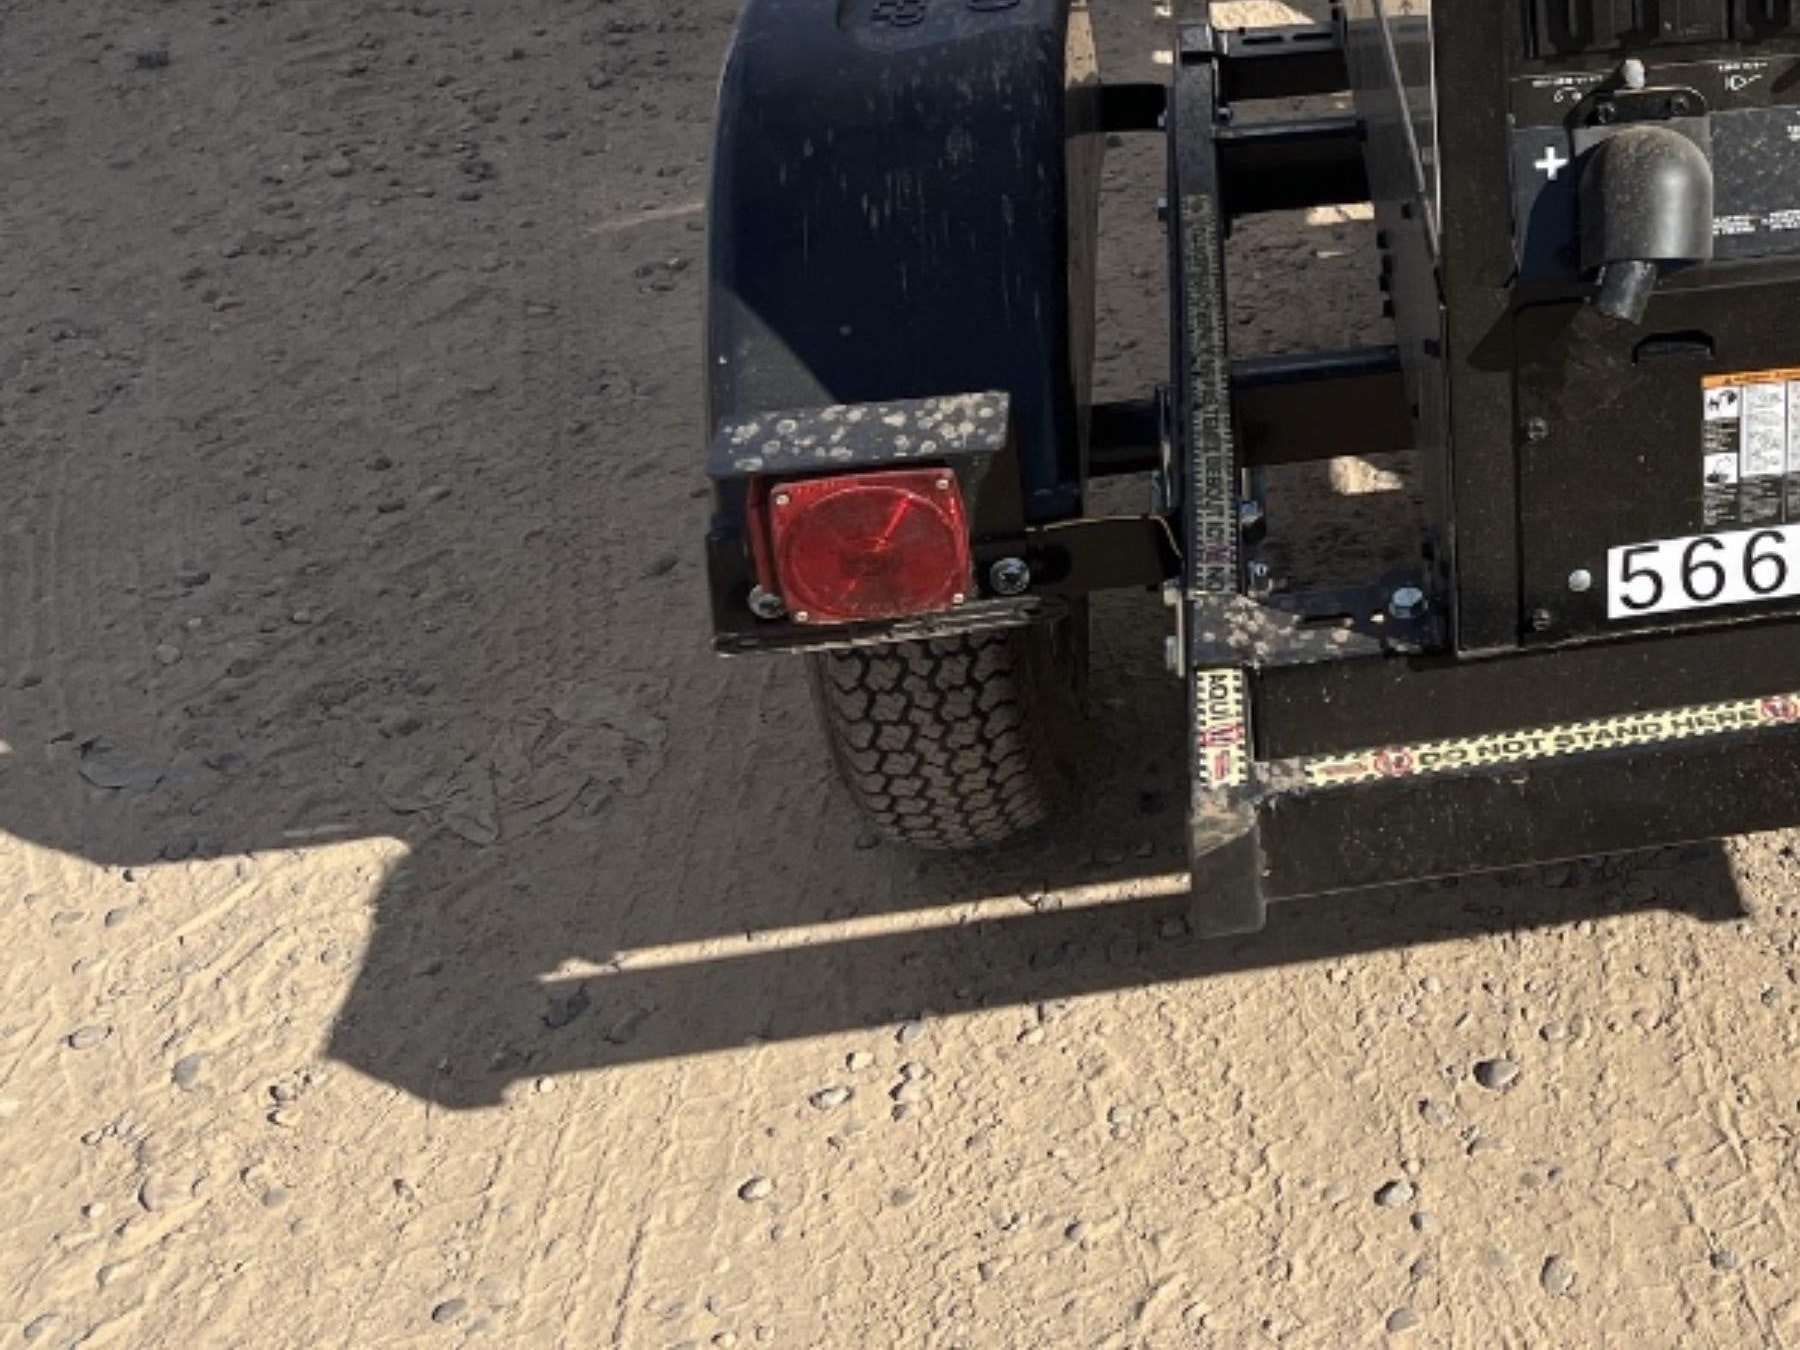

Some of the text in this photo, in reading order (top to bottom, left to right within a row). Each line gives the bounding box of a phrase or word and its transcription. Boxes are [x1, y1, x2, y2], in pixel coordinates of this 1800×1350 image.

[1477, 736, 1544, 758] NOT
[1554, 723, 1664, 748] STAND
[1670, 709, 1760, 729] HERE
